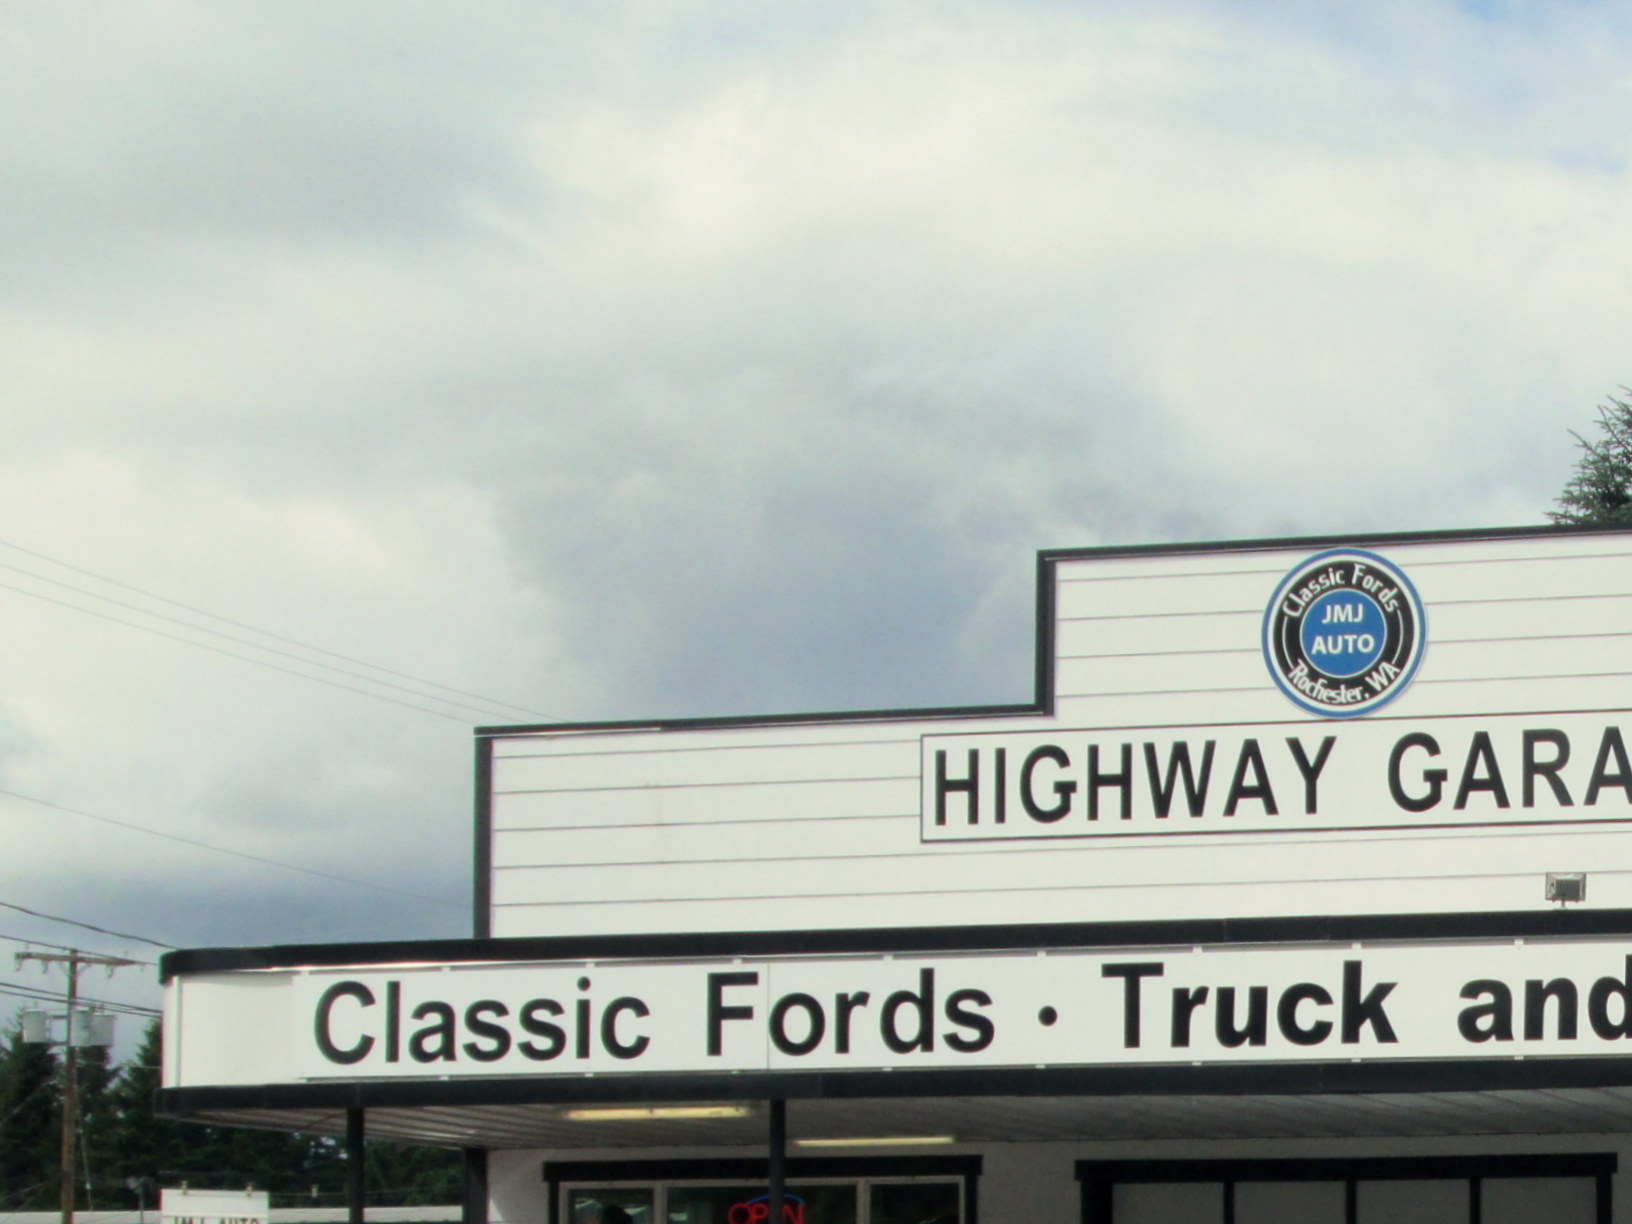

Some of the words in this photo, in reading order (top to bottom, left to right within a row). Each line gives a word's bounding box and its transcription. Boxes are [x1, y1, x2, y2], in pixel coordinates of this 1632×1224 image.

[1282, 567, 1346, 618] Classic
[1351, 562, 1399, 614] Fords
[1321, 603, 1364, 624] JMJ
[1311, 634, 1376, 655] AUTO
[1364, 661, 1401, 693] WA
[935, 736, 1337, 826] HIGHWAY
[314, 976, 651, 1065] Classic
[707, 967, 996, 1056] Fords
[1101, 960, 1399, 1049] Truck
